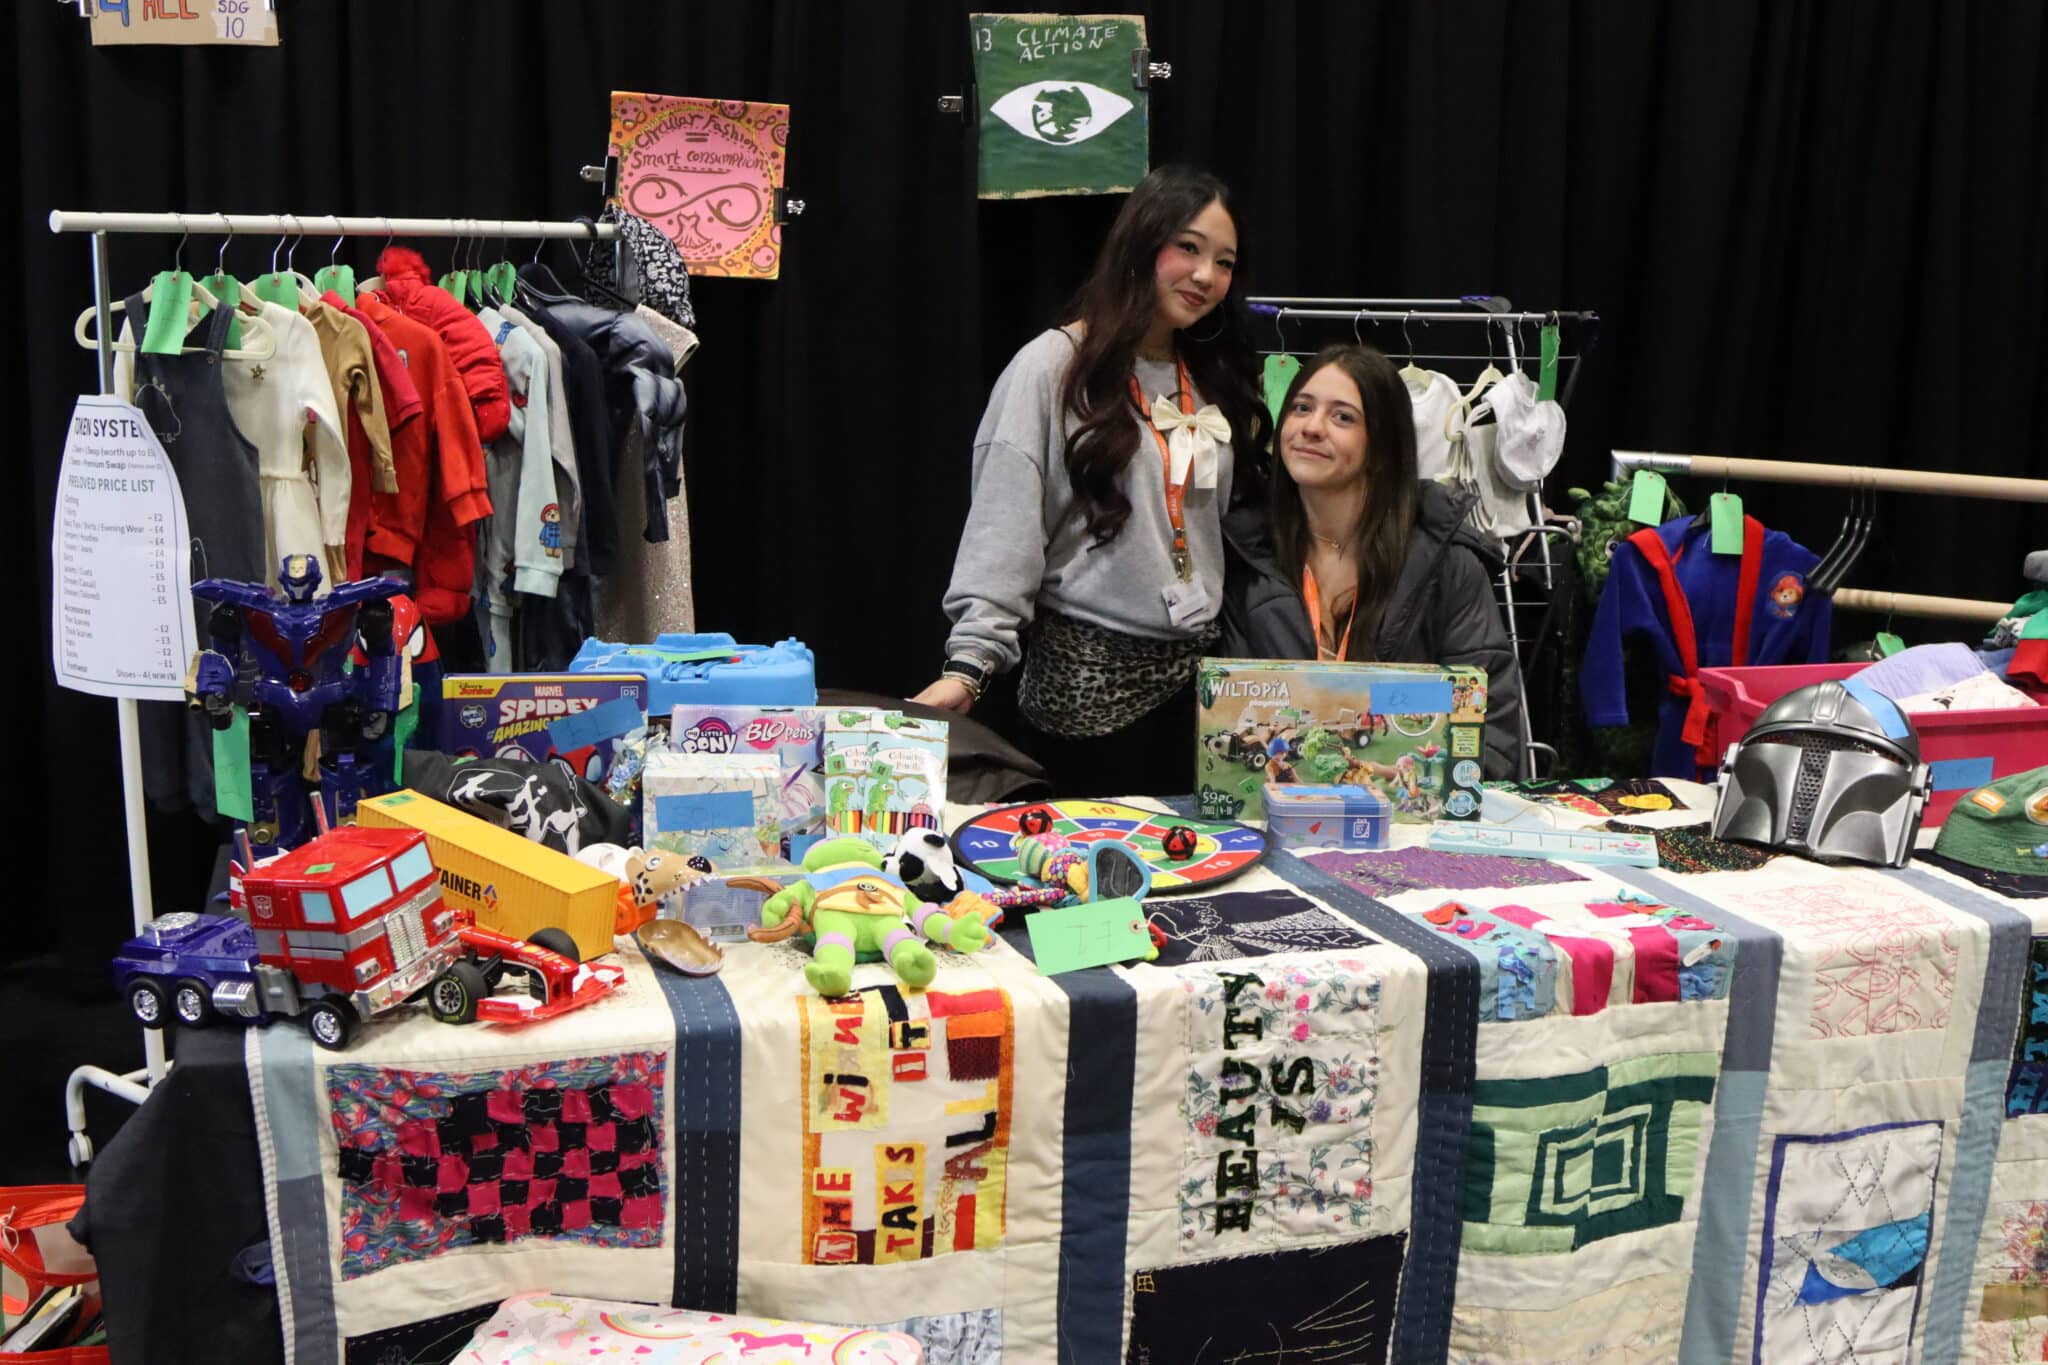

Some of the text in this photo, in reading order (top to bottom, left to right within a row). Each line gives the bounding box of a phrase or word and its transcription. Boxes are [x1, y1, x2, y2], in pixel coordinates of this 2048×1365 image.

[218, 0, 249, 14] SDG
[225, 16, 245, 38] 10
[1016, 26, 1119, 46] CLIMATE
[975, 28, 992, 51] 13
[1019, 39, 1103, 63] ACTION
[704, 115, 758, 153] Fashion
[633, 150, 680, 169] Smart
[93, 419, 147, 438] SYSTE
[98, 478, 128, 492] PRICE
[131, 479, 155, 492] LIST
[534, 685, 564, 697] MARVEL
[499, 698, 599, 724] SPIDEY
[1088, 806, 1117, 815] 10
[970, 840, 1000, 849] 10
[1229, 834, 1258, 844] 10
[1203, 859, 1233, 870] 10
[436, 867, 482, 901] AINER
[1213, 969, 1266, 1236] BEAUTY
[1270, 1054, 1316, 1135] IS
[944, 1081, 998, 1182] ALL
[815, 1172, 853, 1258] THE
